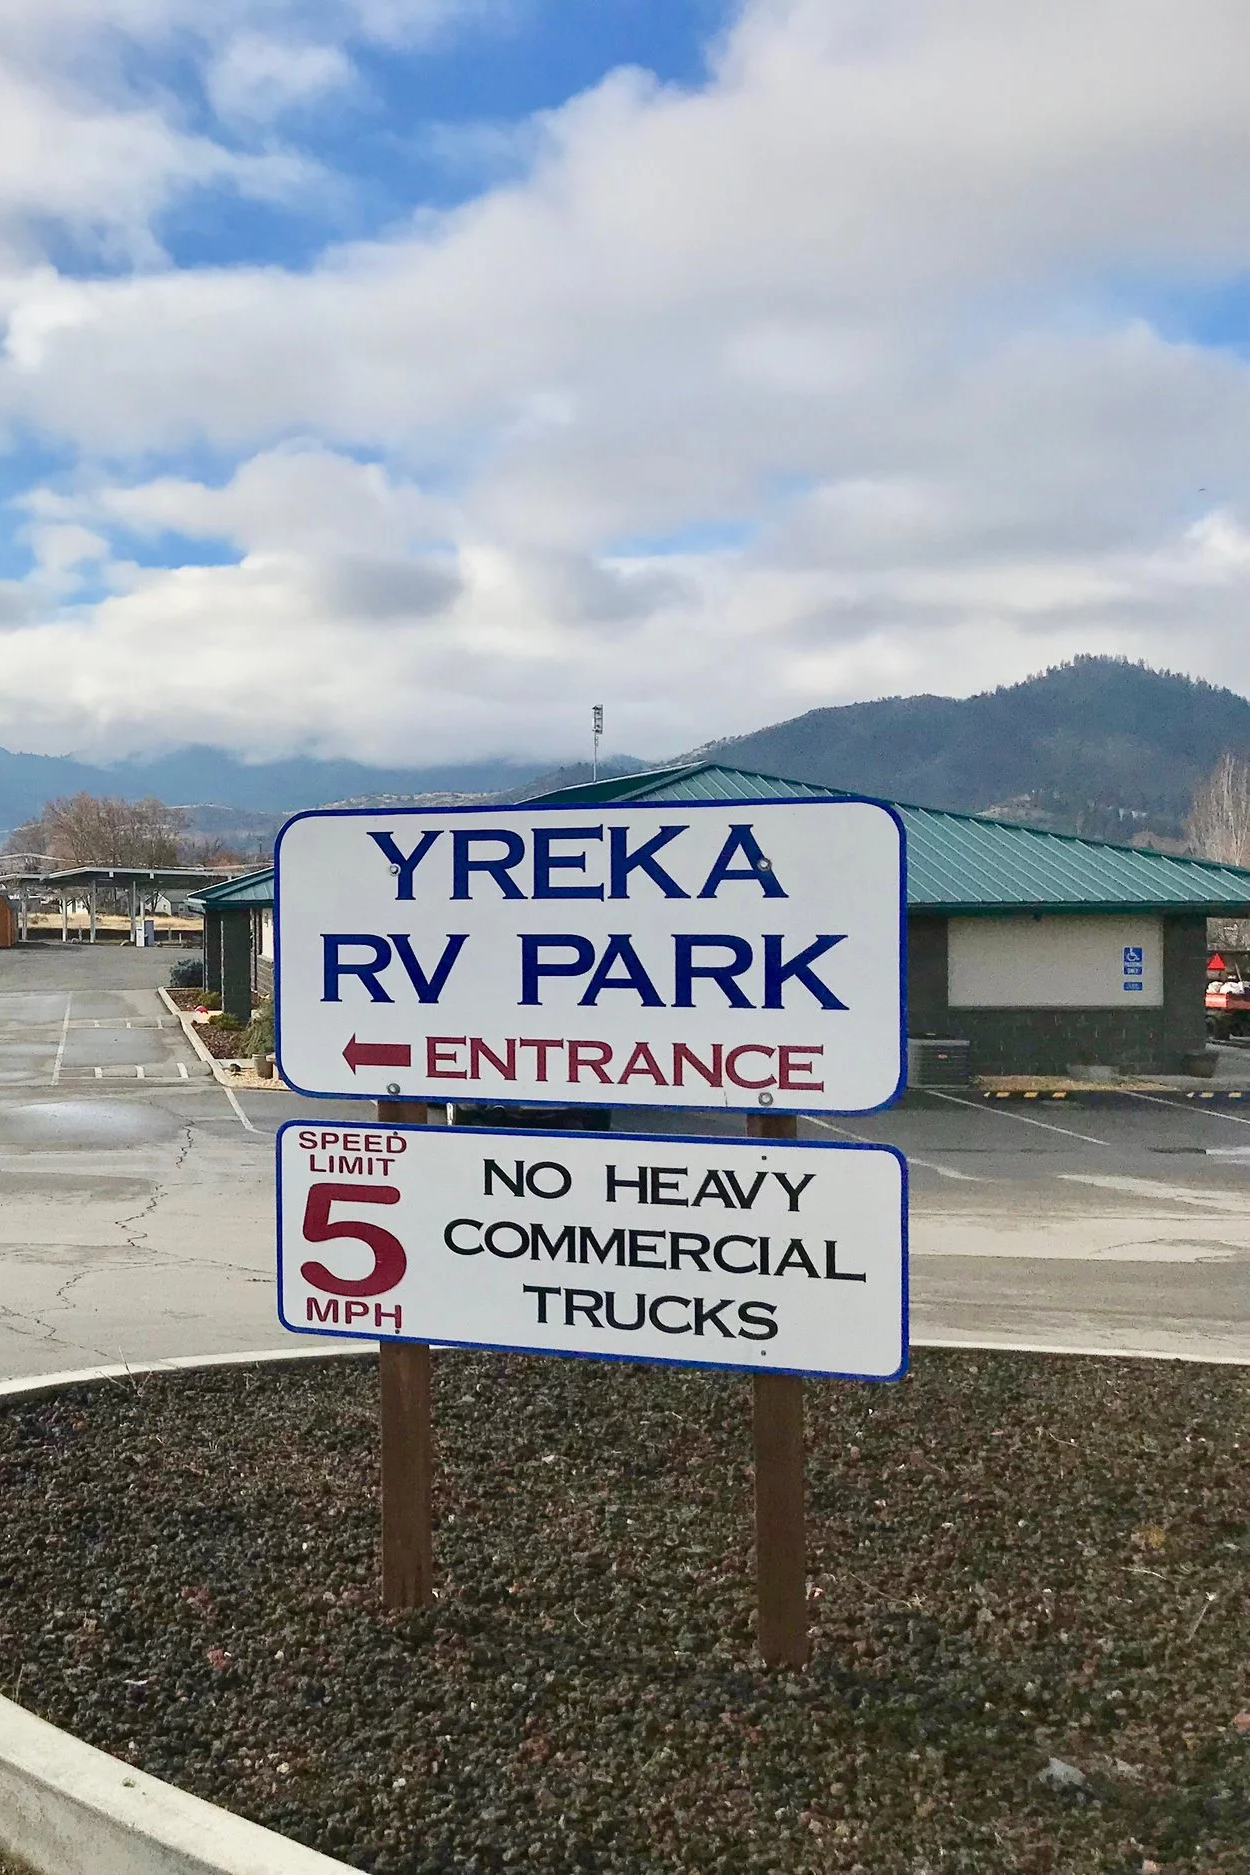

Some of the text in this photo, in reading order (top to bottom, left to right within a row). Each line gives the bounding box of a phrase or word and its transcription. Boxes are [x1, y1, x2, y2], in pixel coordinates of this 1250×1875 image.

[366, 824, 789, 902] YREKA
[320, 934, 850, 1010] RV PARK
[426, 1036, 824, 1092] ENTRANCE
[299, 1131, 407, 1154] SPEED
[309, 1154, 395, 1177] LIMIT
[483, 1159, 816, 1212] NO HEAVY
[300, 1183, 407, 1297] 5
[444, 1219, 866, 1283] COMMERCIAL
[307, 1298, 401, 1330] MPH
[523, 1284, 778, 1340] TRUCKS
